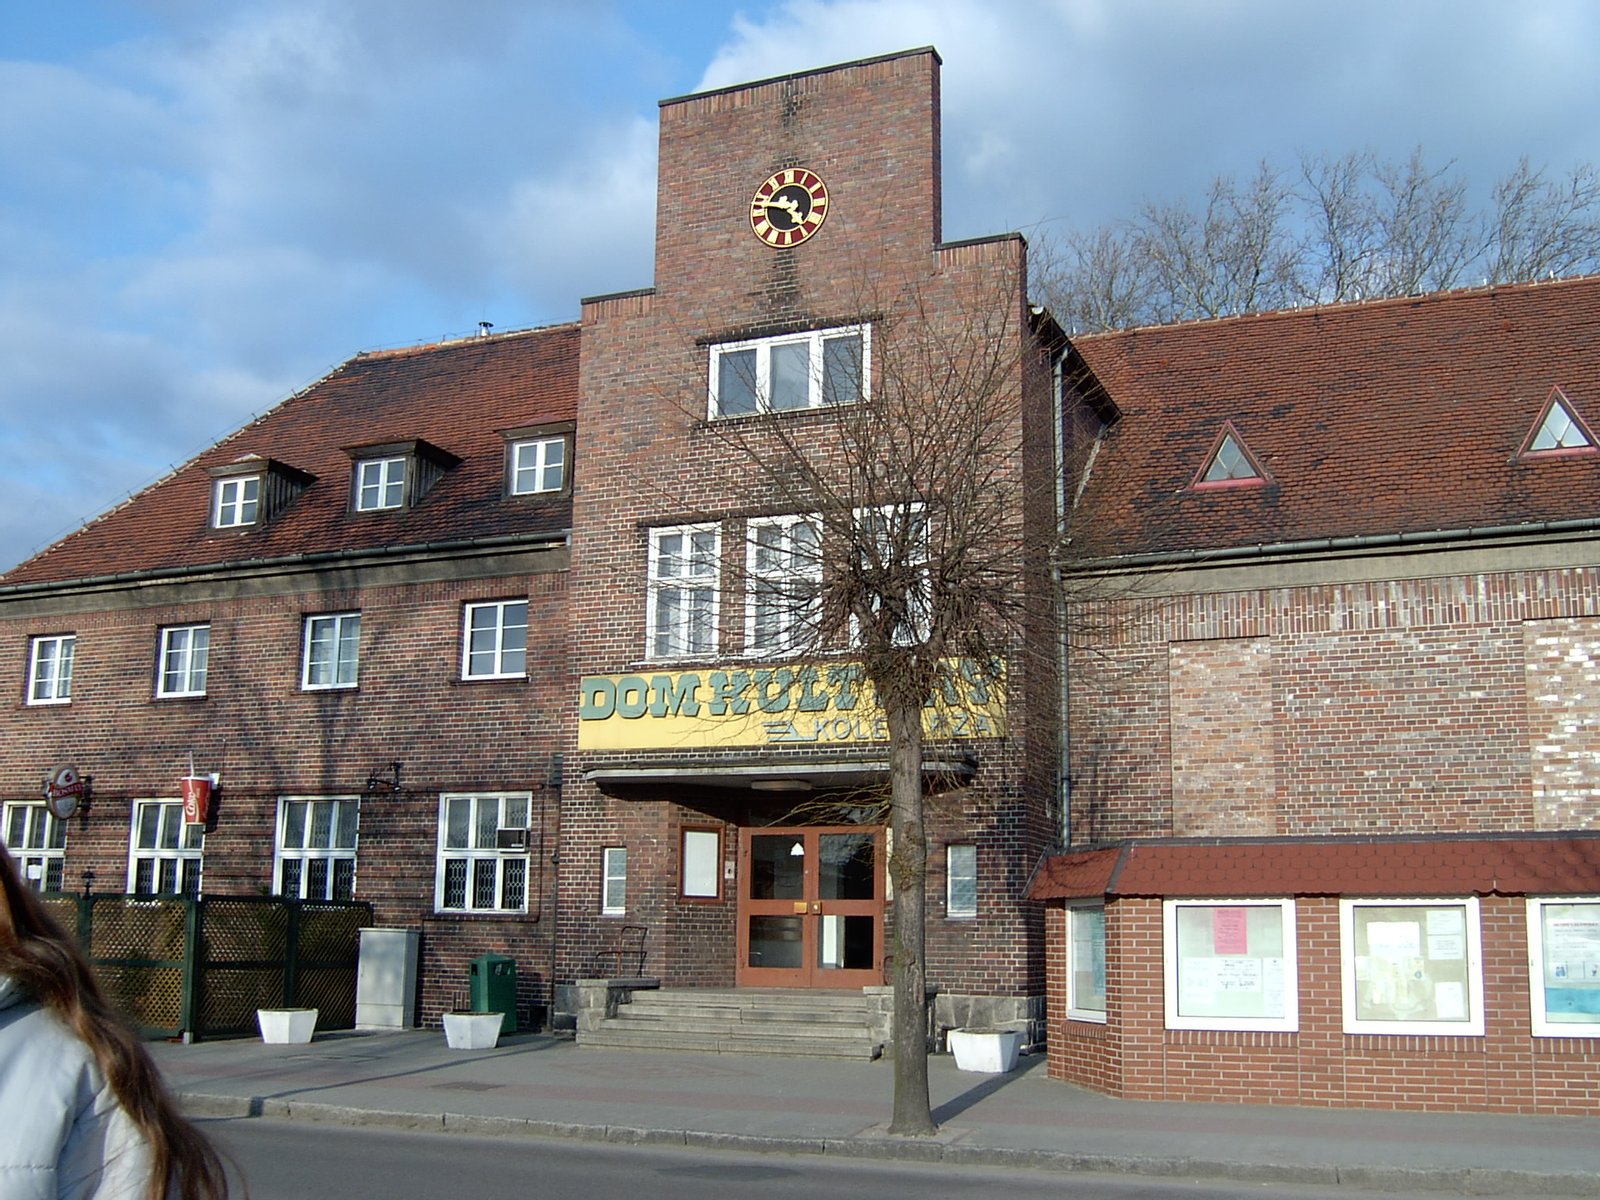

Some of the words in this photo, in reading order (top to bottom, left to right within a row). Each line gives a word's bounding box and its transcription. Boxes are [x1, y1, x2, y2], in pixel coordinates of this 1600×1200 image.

[580, 674, 701, 721] DOM
[709, 657, 1001, 716] KULTY
[813, 711, 991, 741] KOLERZA
